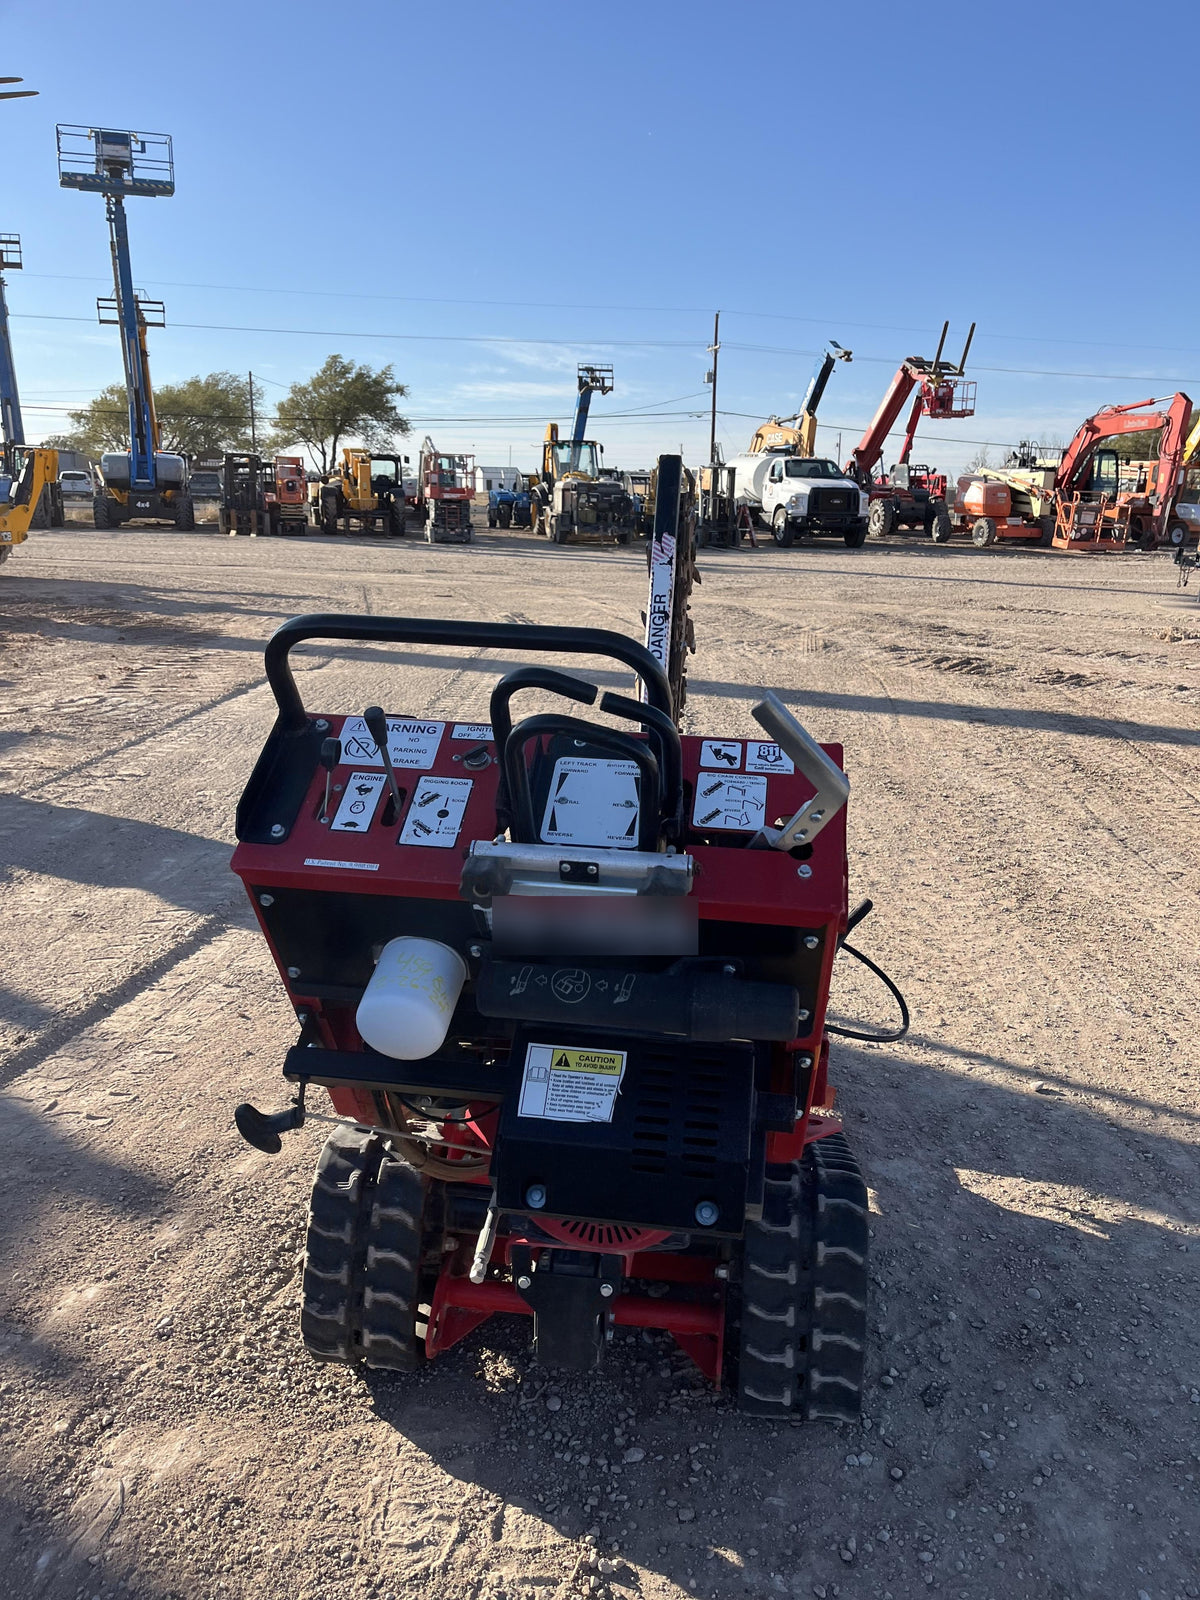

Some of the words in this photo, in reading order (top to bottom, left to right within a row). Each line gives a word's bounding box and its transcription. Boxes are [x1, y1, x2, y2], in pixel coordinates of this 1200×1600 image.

[651, 594, 667, 660] DANGER
[387, 723, 437, 735] RNING
[759, 745, 781, 757] 811
[352, 774, 384, 783] ENGINE
[578, 1054, 616, 1065] CAUTION
